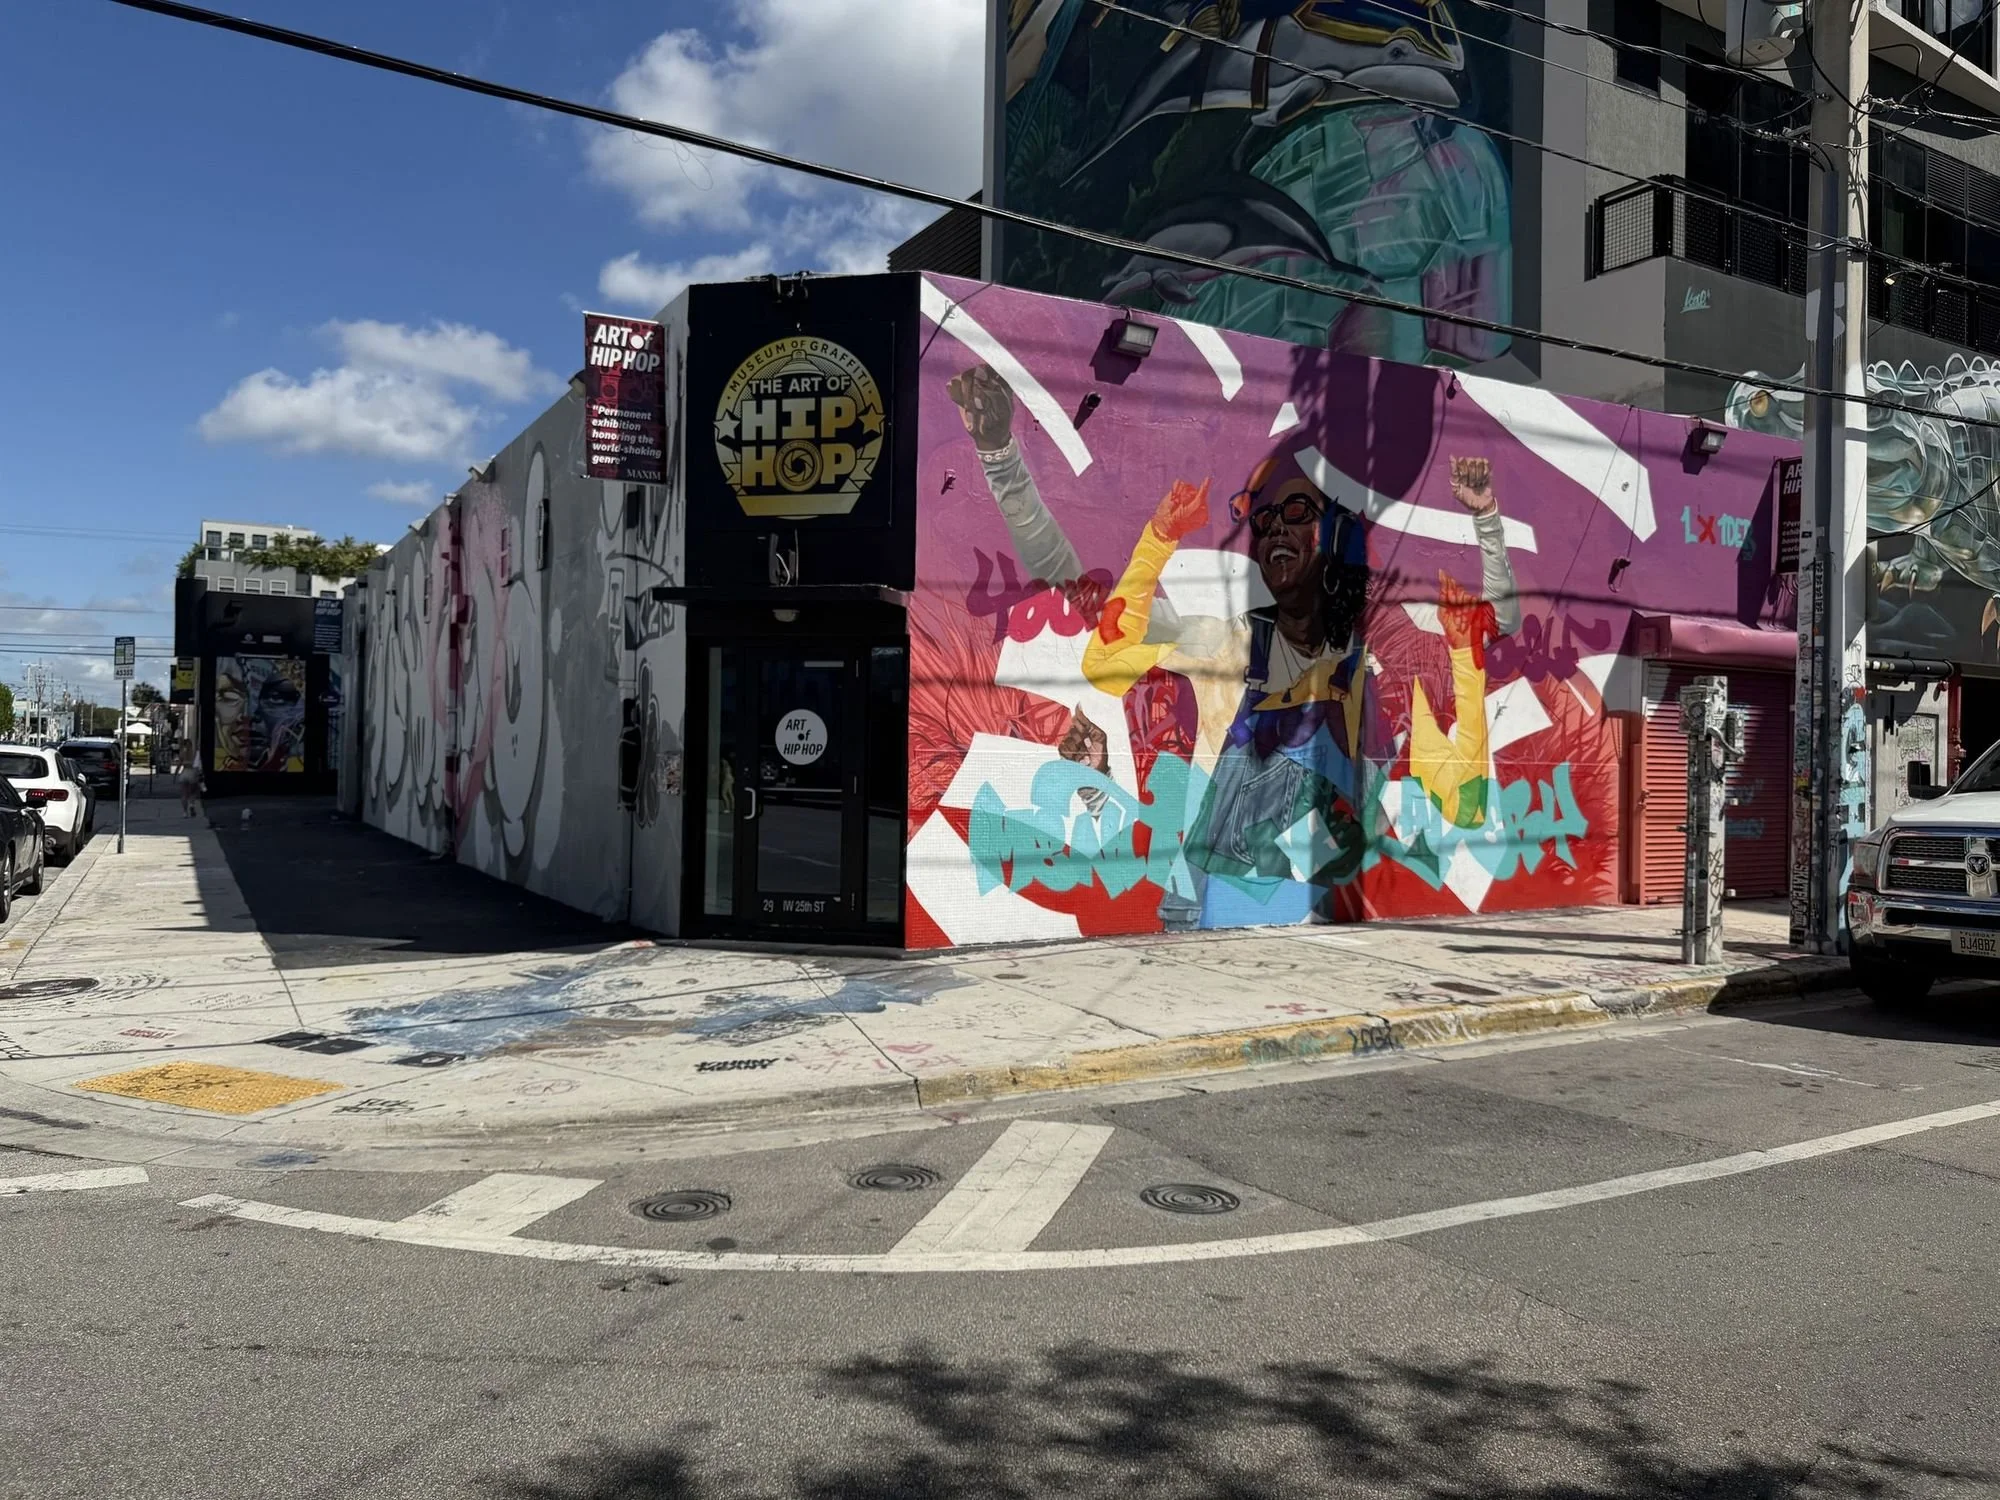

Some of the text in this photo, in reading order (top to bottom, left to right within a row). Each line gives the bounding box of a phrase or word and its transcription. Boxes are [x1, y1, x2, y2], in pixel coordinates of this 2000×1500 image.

[593, 324, 633, 347] ART
[590, 346, 661, 373] HIP HOP
[730, 340, 872, 392] MUSEUM OF GRAFFITI
[749, 376, 850, 394] THE ART OF
[592, 404, 652, 420] "Permanent
[741, 396, 857, 441] HIP
[591, 418, 642, 432] exhibition
[591, 429, 654, 445] honoring the
[591, 442, 662, 459] world-shaking
[741, 441, 857, 492] HOP
[1785, 463, 1803, 479] AR
[627, 469, 661, 481] MAXIM
[785, 719, 808, 731] ART
[783, 743, 824, 755] HIP HOP
[763, 899, 774, 913] 29
[813, 900, 826, 912] ST
